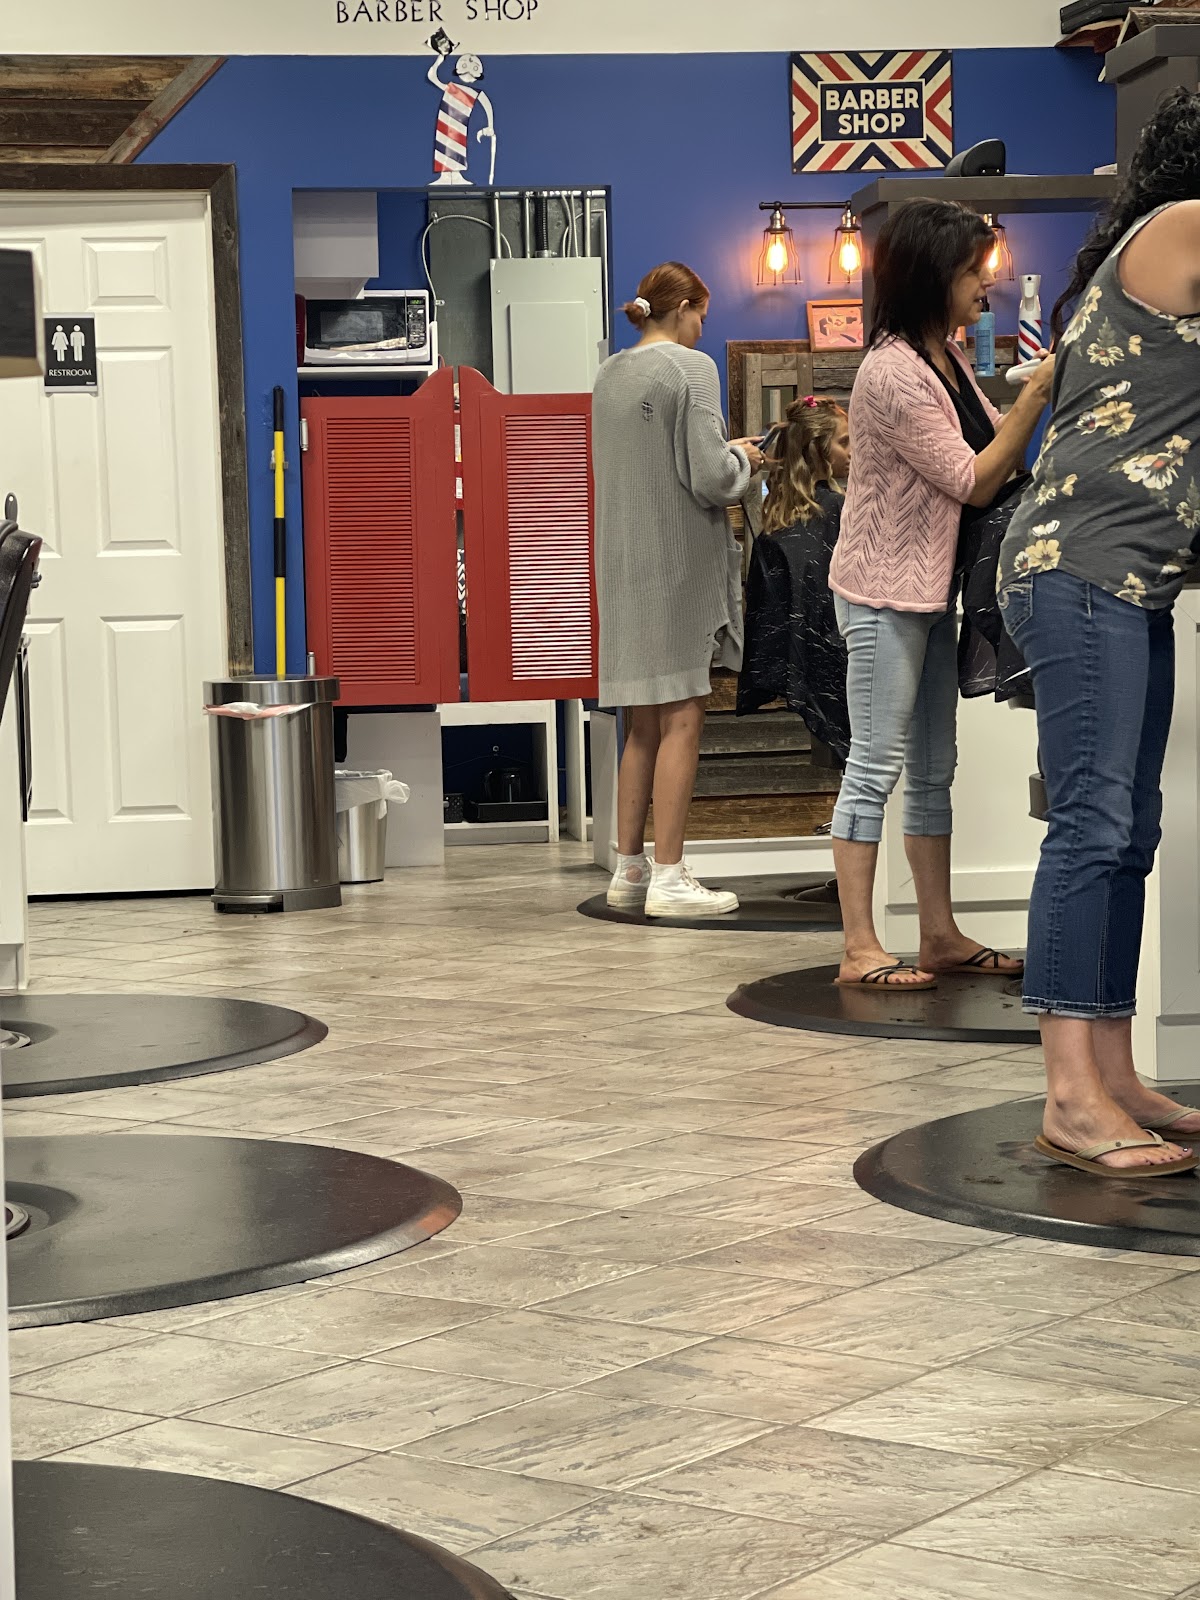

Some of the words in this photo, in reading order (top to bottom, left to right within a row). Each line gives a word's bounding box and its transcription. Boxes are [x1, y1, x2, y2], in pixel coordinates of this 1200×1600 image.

[336, 0, 443, 23] BARBER
[466, 0, 538, 21] SHOP
[825, 88, 919, 111] BARBER
[838, 112, 906, 135] SHOP
[48, 368, 92, 377] RESTROOM
